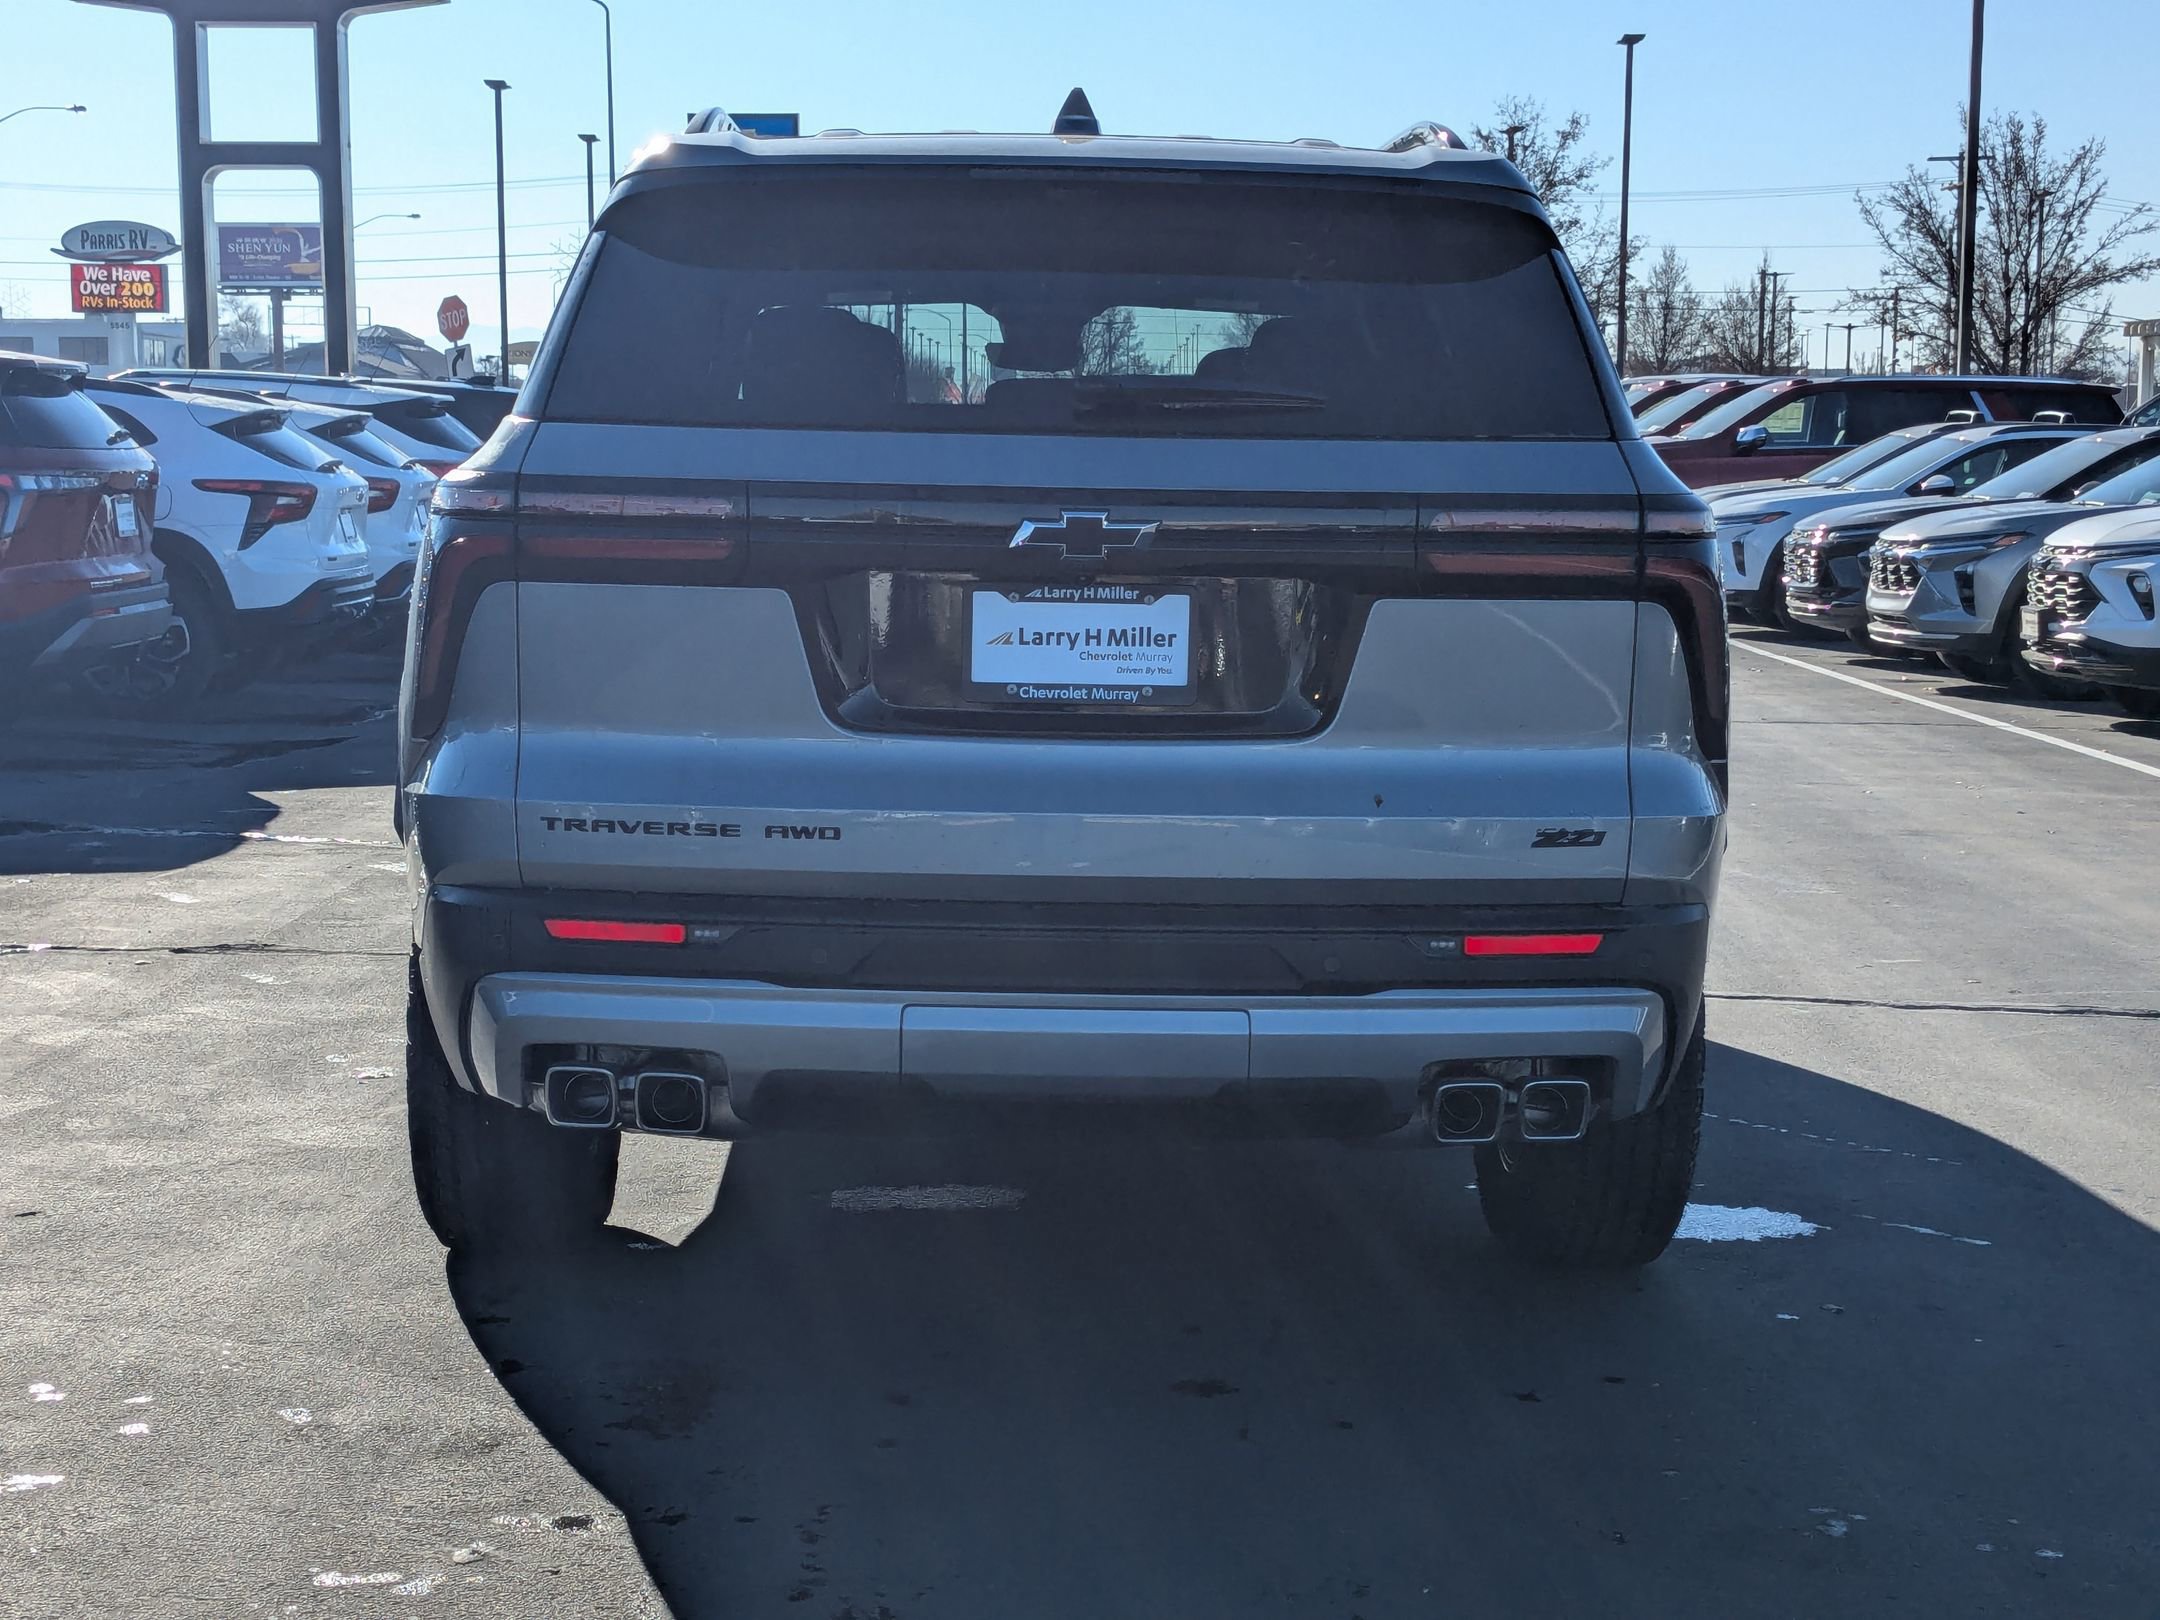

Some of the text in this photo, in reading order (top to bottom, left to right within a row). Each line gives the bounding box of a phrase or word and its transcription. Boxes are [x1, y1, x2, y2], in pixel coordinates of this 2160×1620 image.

[80, 229, 149, 250] PARRIS RV
[227, 243, 291, 253] SHEN YUN
[83, 266, 151, 282] We Have
[80, 281, 155, 296] Over 200
[82, 296, 154, 309] RVs In-Stock
[440, 308, 466, 331] STOP
[1044, 586, 1140, 601] Larry H Miller
[1018, 626, 1177, 651] Larry H Miller
[1079, 651, 1173, 664] Chevrolet Murray
[1116, 666, 1144, 675] Driven
[1145, 667, 1156, 676] By
[1019, 686, 1139, 703] Chevrolet Murray
[540, 816, 842, 841] TRAVERSE AWD
